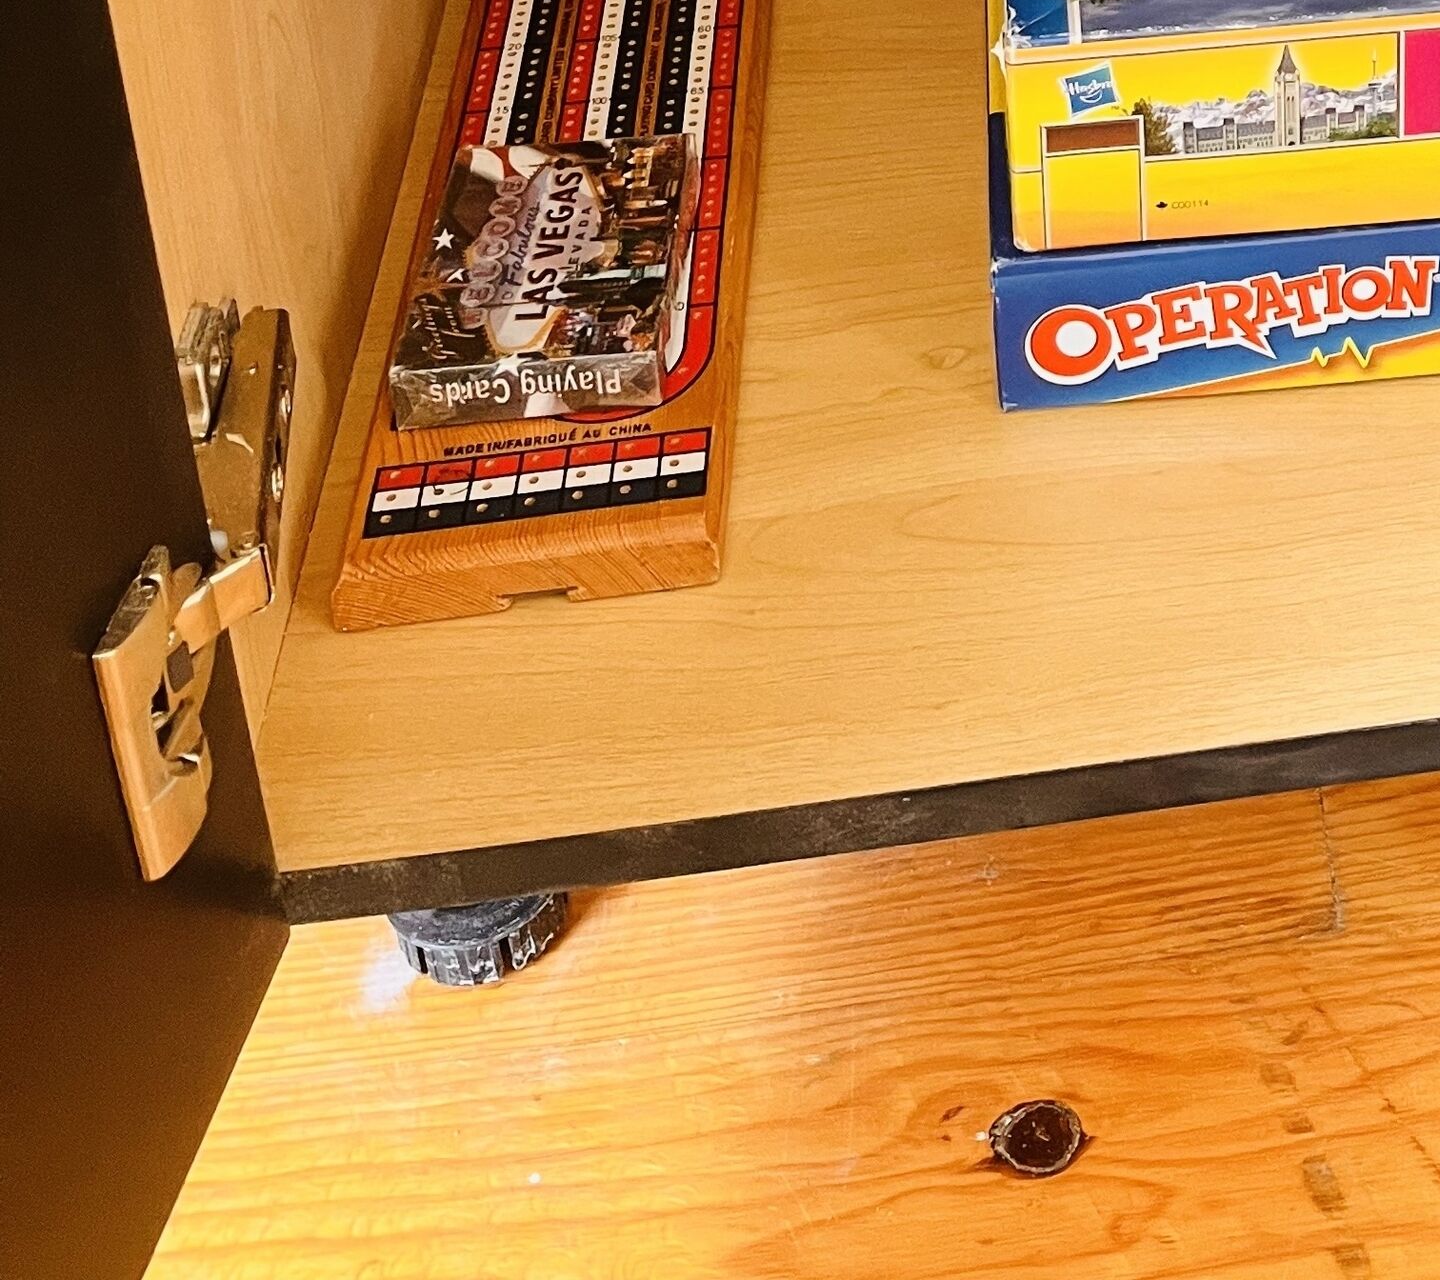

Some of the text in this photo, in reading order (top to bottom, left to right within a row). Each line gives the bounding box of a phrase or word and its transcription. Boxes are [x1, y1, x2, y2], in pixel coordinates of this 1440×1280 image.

[1066, 77, 1117, 102] Hasbro
[514, 171, 584, 321] LAS VEGAS
[1026, 257, 1440, 384] OPERATION
[429, 364, 622, 404] Playing Cards
[443, 443, 484, 457] MADE
[582, 429, 601, 439] AU
[609, 422, 652, 438] CHINA
